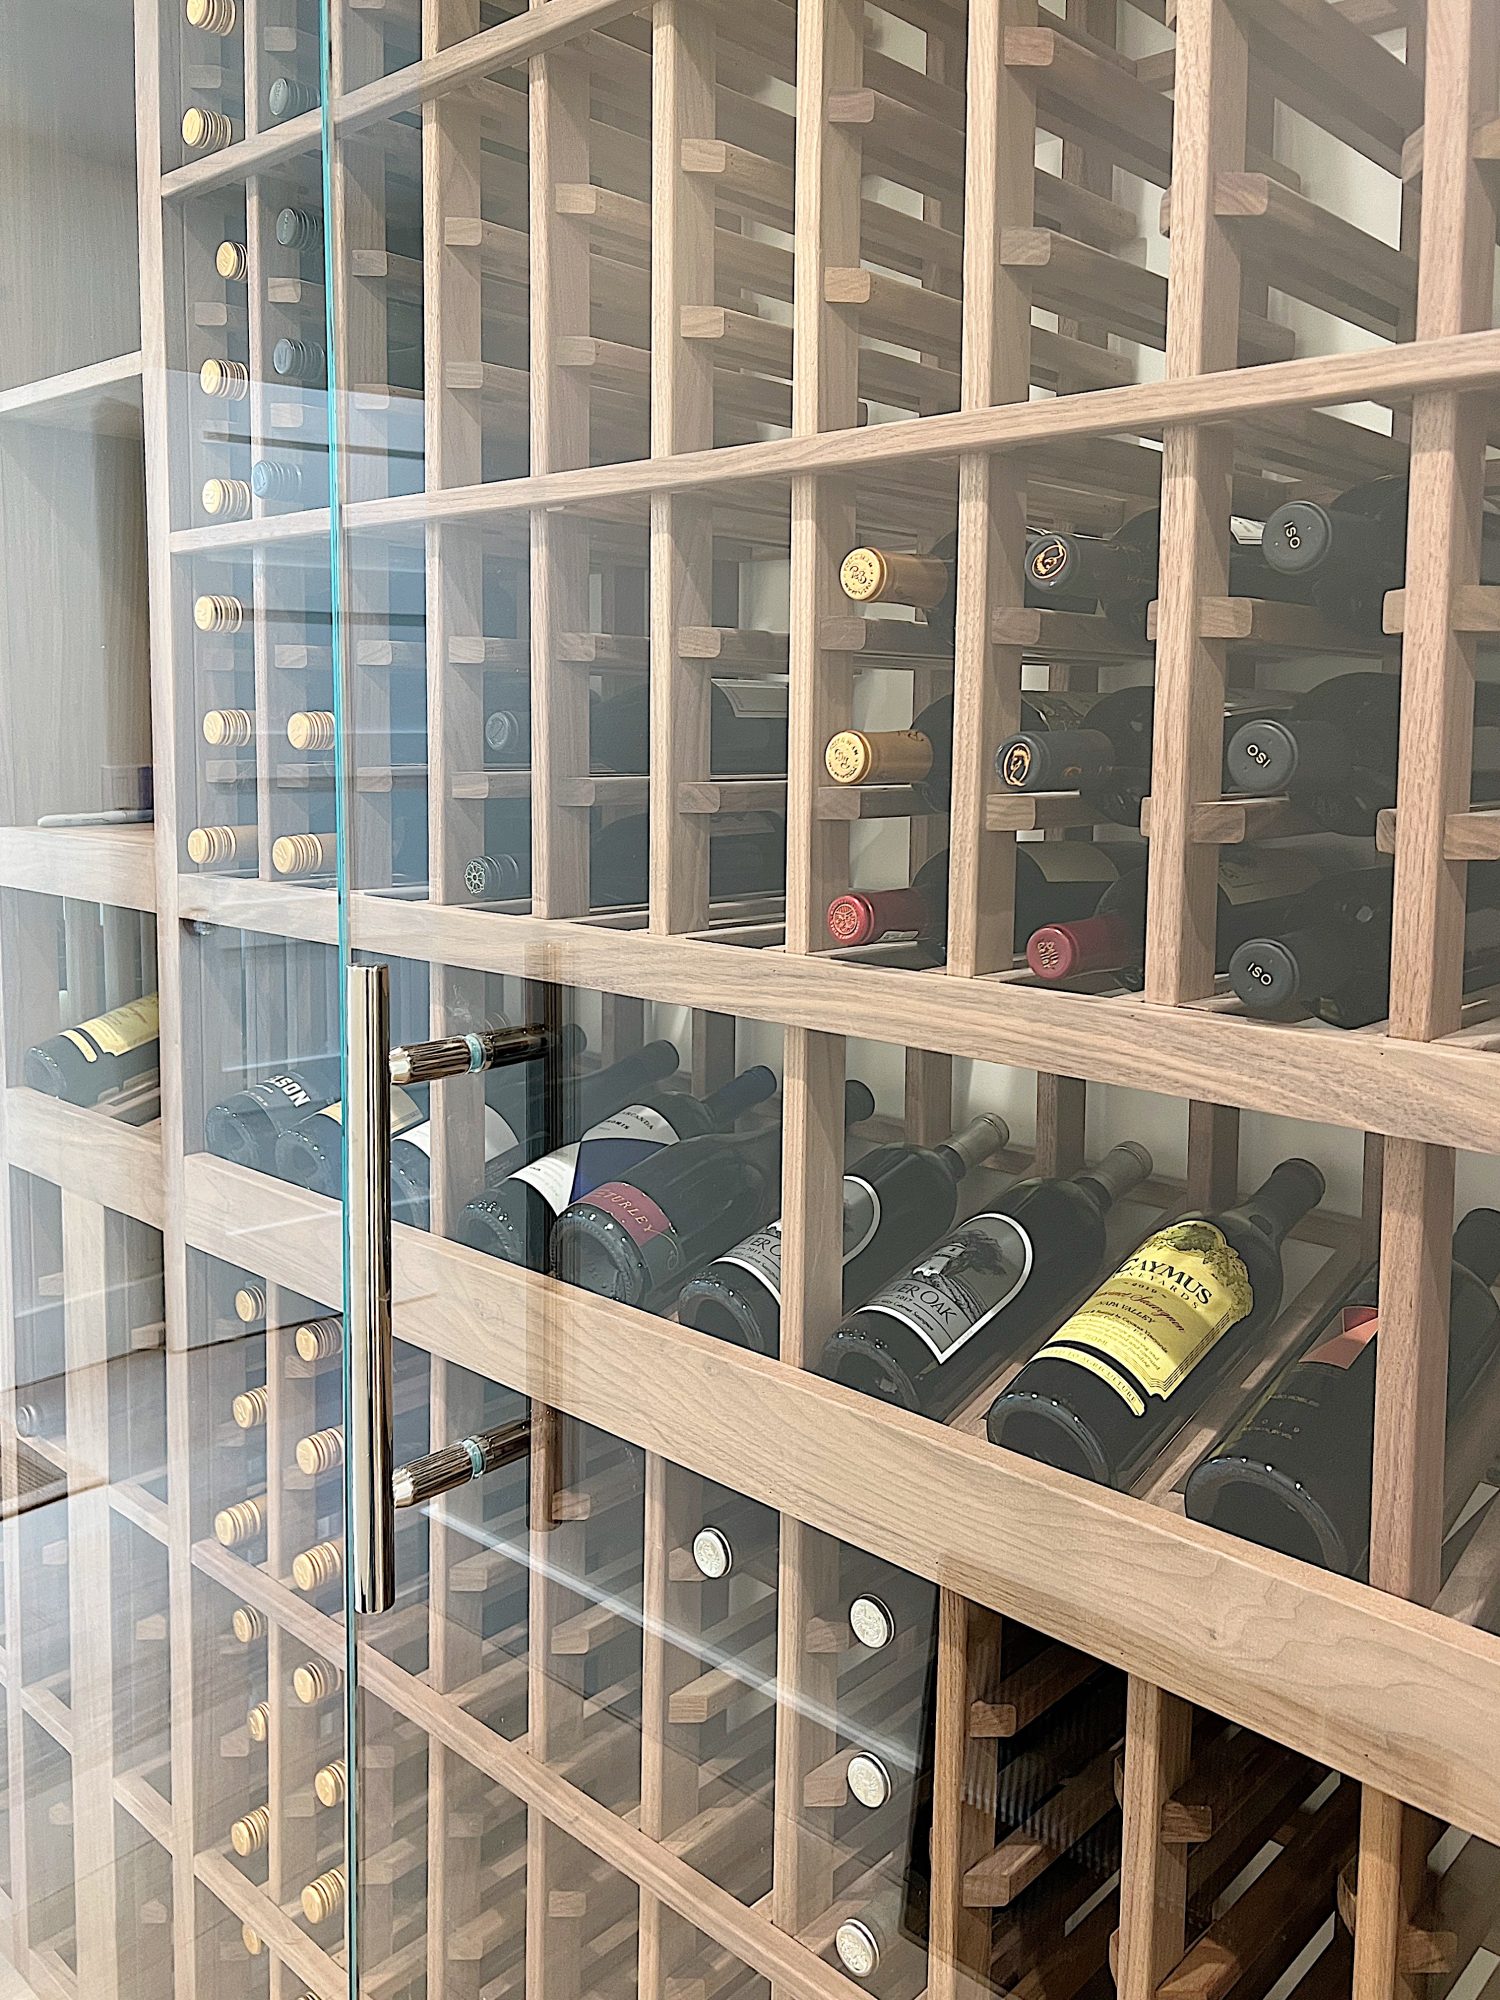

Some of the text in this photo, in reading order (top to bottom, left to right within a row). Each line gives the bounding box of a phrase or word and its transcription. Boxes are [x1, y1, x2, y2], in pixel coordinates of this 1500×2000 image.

[1283, 521, 1302, 549] ISO
[1247, 962, 1272, 986] ISO
[1117, 1257, 1213, 1306] CAYMUS
[920, 1290, 958, 1325] OAK
